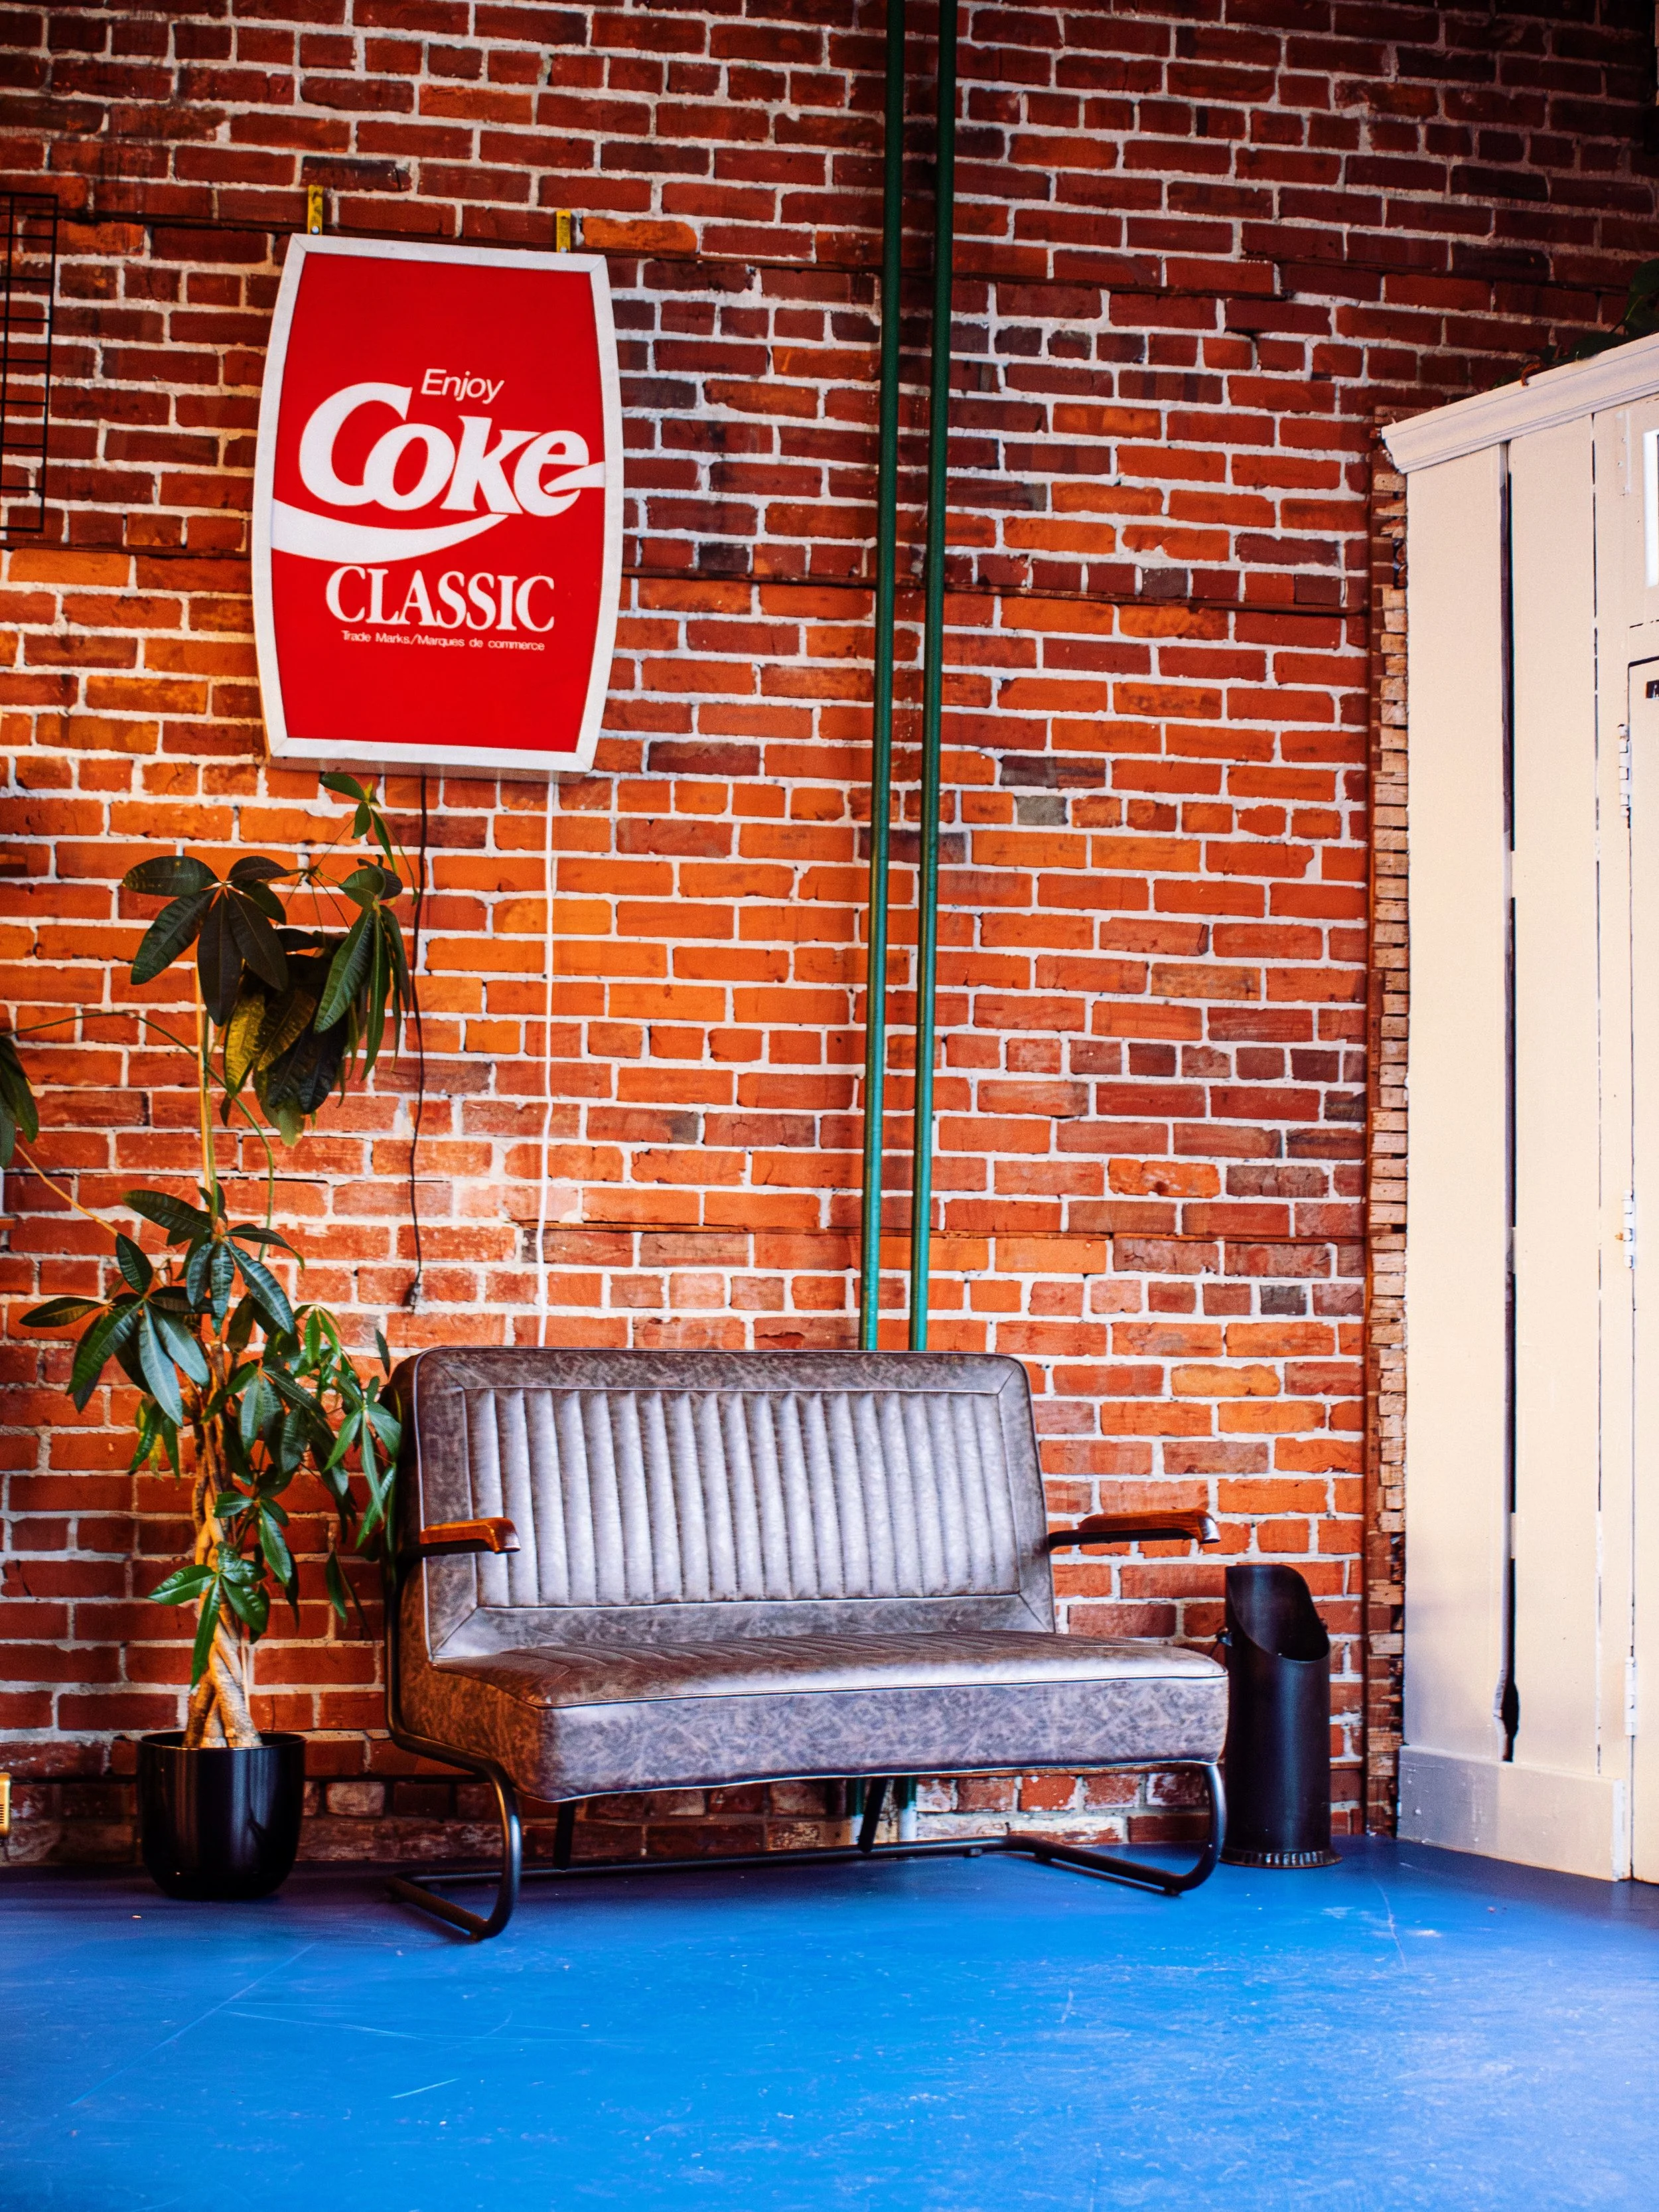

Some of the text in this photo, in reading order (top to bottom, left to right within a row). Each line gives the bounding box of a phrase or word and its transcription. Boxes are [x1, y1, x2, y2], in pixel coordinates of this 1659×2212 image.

[421, 368, 505, 404] Enjoy
[299, 382, 591, 516] Coke
[326, 565, 555, 632] CLASSIC
[342, 630, 545, 651] Trade Marks/Marques de commerce
